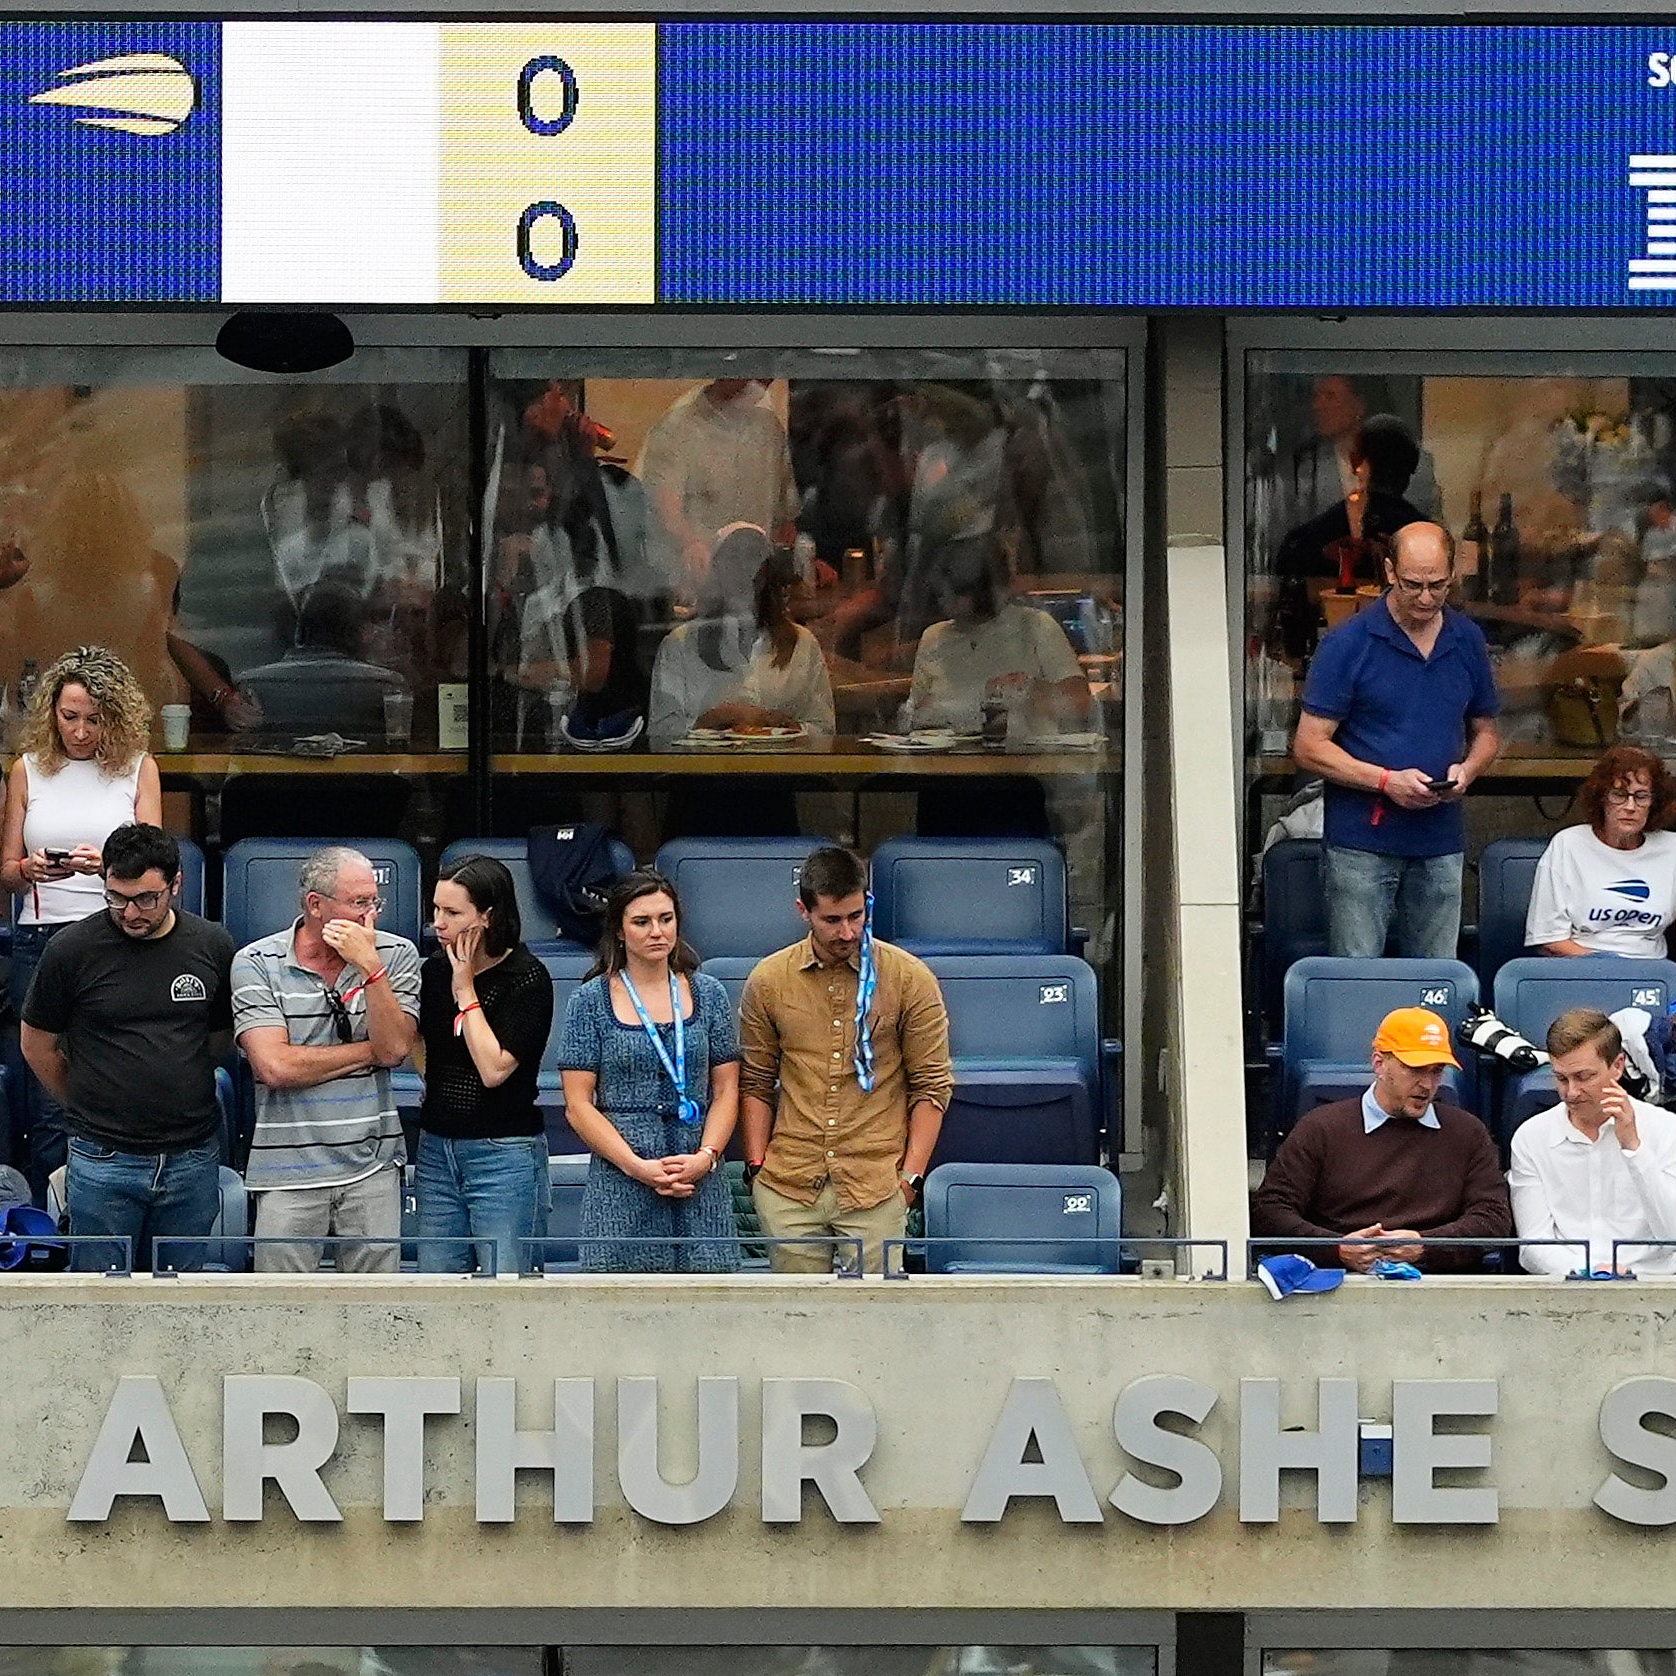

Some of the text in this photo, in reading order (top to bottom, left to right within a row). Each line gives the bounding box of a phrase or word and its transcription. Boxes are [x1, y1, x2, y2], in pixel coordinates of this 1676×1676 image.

[517, 55, 578, 136] 0
[517, 200, 578, 281] 0
[1012, 869, 1031, 884] 34
[1614, 909, 1662, 928] open
[1424, 990, 1445, 1004] 46
[1635, 990, 1656, 1005] 45
[65, 1374, 883, 1524] ARTHUR
[960, 1373, 1499, 1524] ASHE
